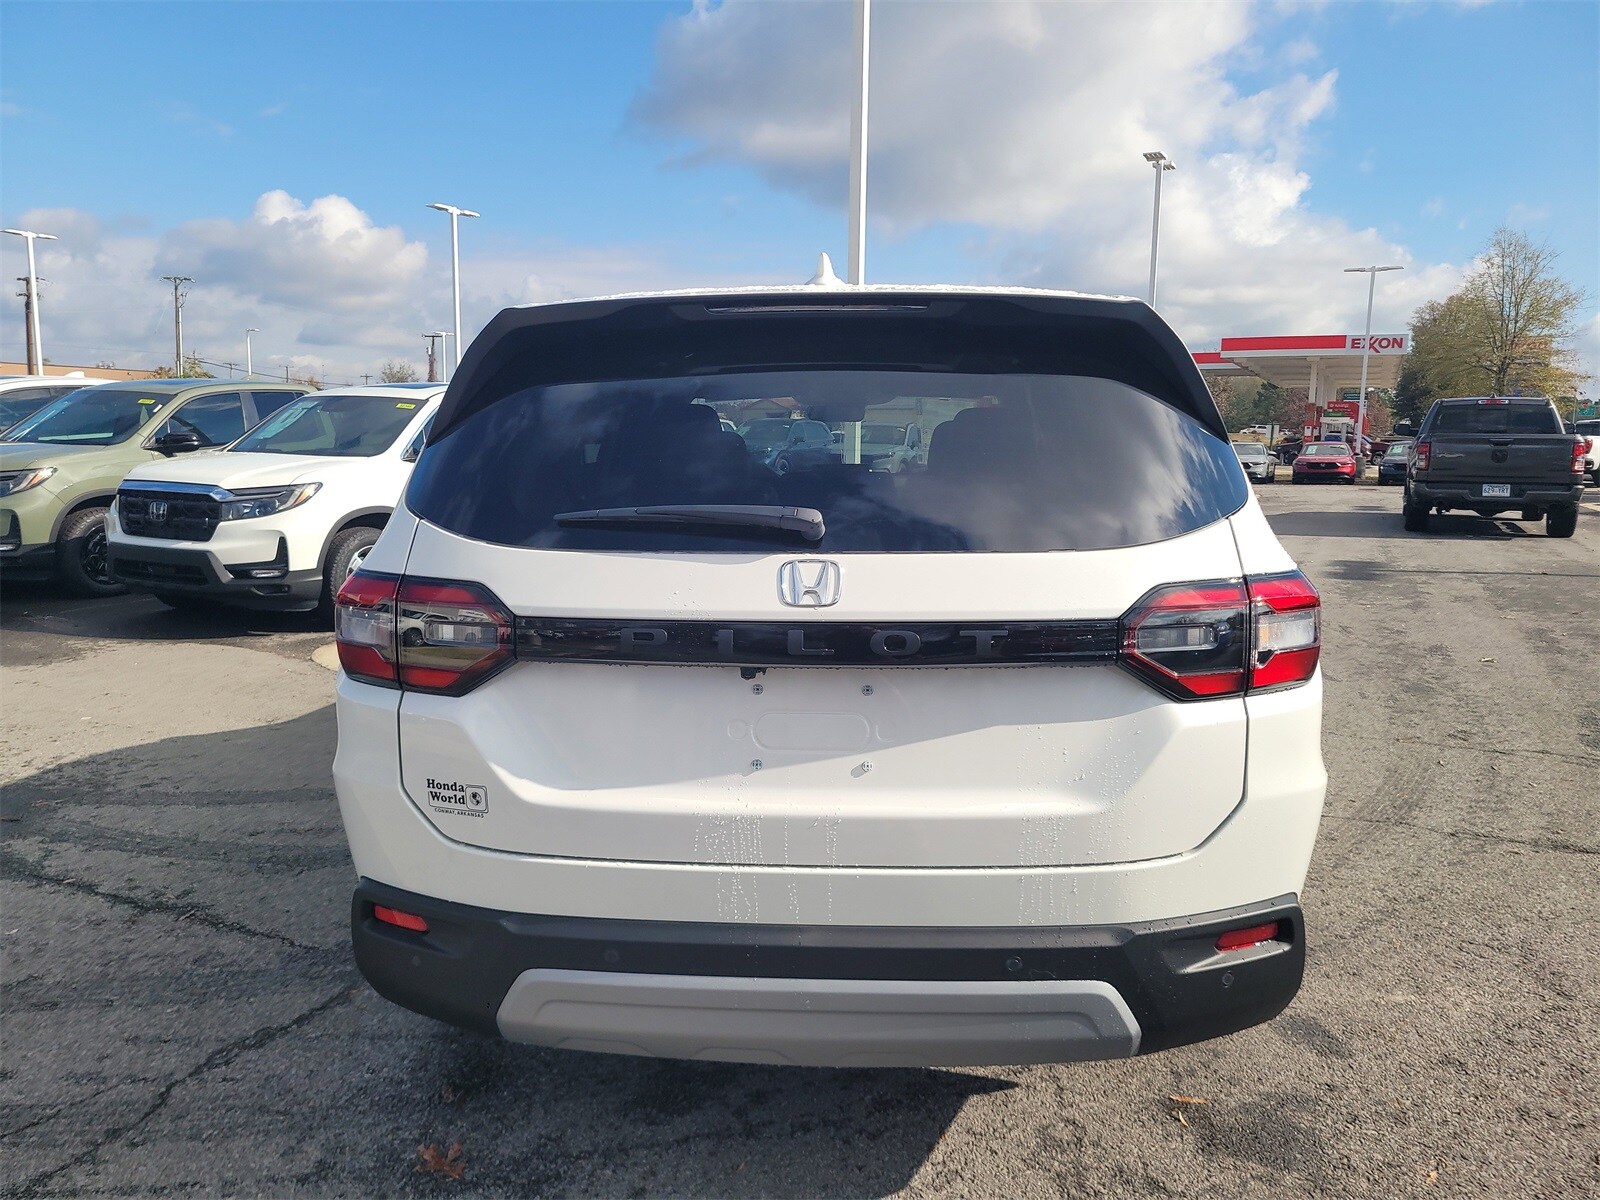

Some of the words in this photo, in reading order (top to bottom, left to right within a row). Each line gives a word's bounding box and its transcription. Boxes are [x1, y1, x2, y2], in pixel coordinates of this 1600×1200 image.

[620, 628, 1009, 655] PILOT
[426, 778, 465, 792] Honda
[429, 791, 466, 805] World
[434, 807, 457, 816] CONWAY,
